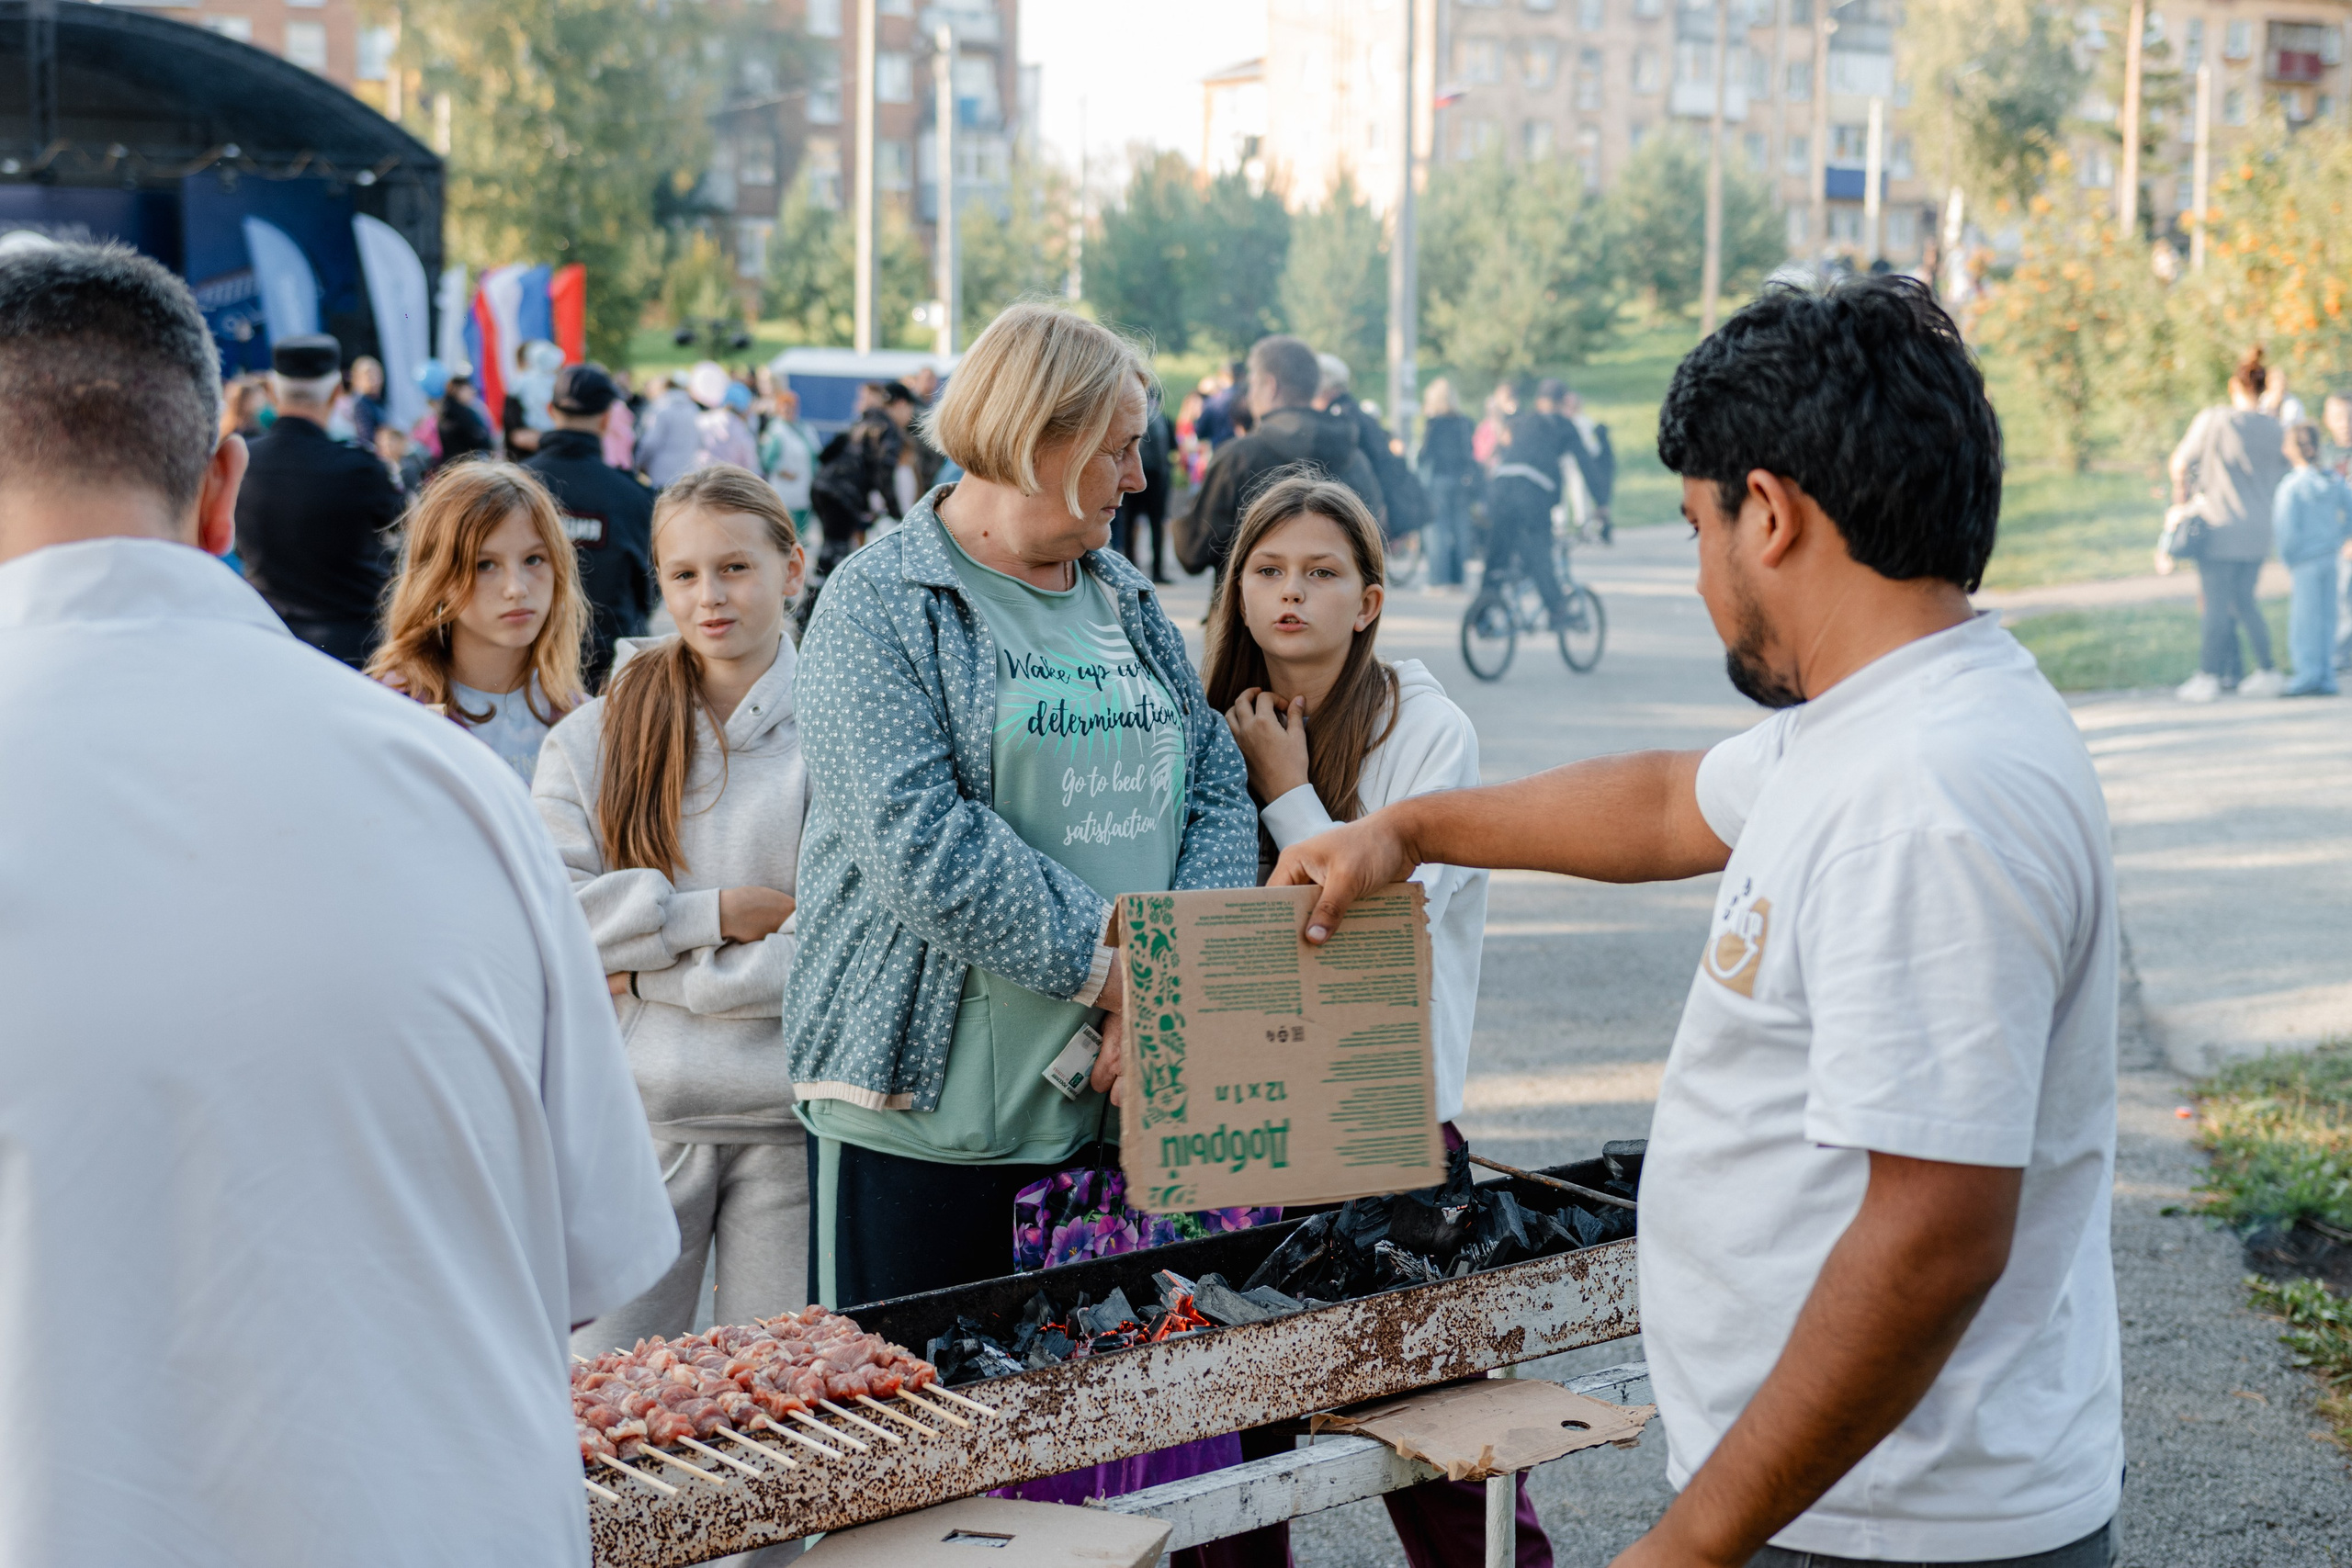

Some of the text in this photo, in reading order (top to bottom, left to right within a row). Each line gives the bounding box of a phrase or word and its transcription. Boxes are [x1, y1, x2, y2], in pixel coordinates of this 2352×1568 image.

[1004, 649, 1070, 684] Wake
[1078, 663, 1110, 692] up
[1062, 767, 1087, 807] Go
[1087, 766, 1109, 798] to
[1113, 761, 1148, 792] bed
[1063, 808, 1157, 845] satisfaction
[1265, 1081, 1287, 1101] 12
[1159, 1118, 1291, 1179] Добрый
